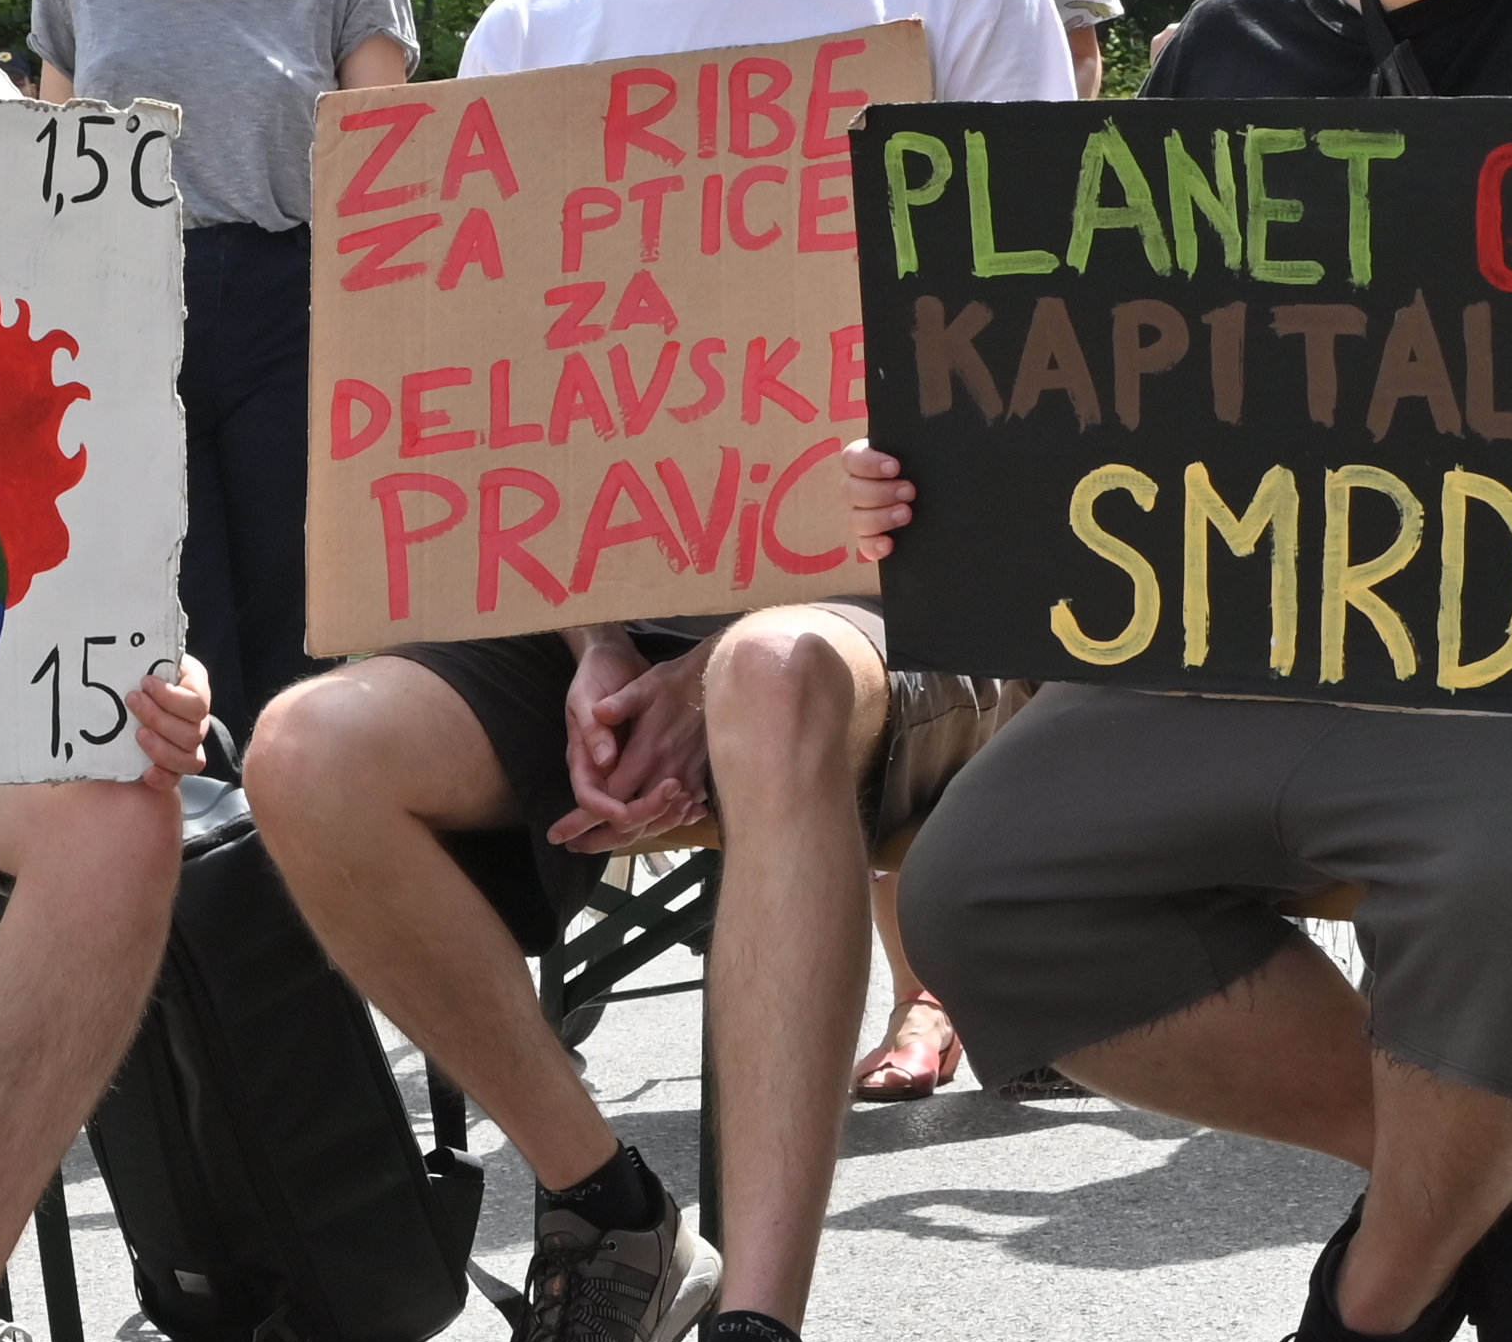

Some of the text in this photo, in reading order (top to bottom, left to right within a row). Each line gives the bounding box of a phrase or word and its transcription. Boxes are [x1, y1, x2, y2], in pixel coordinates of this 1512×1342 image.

[336, 39, 869, 217] ZA RIBE
[336, 161, 858, 291] ZA PTICE
[884, 117, 1405, 289] PLANET
[543, 270, 678, 350] ZA
[329, 324, 869, 460] DELAVSKE
